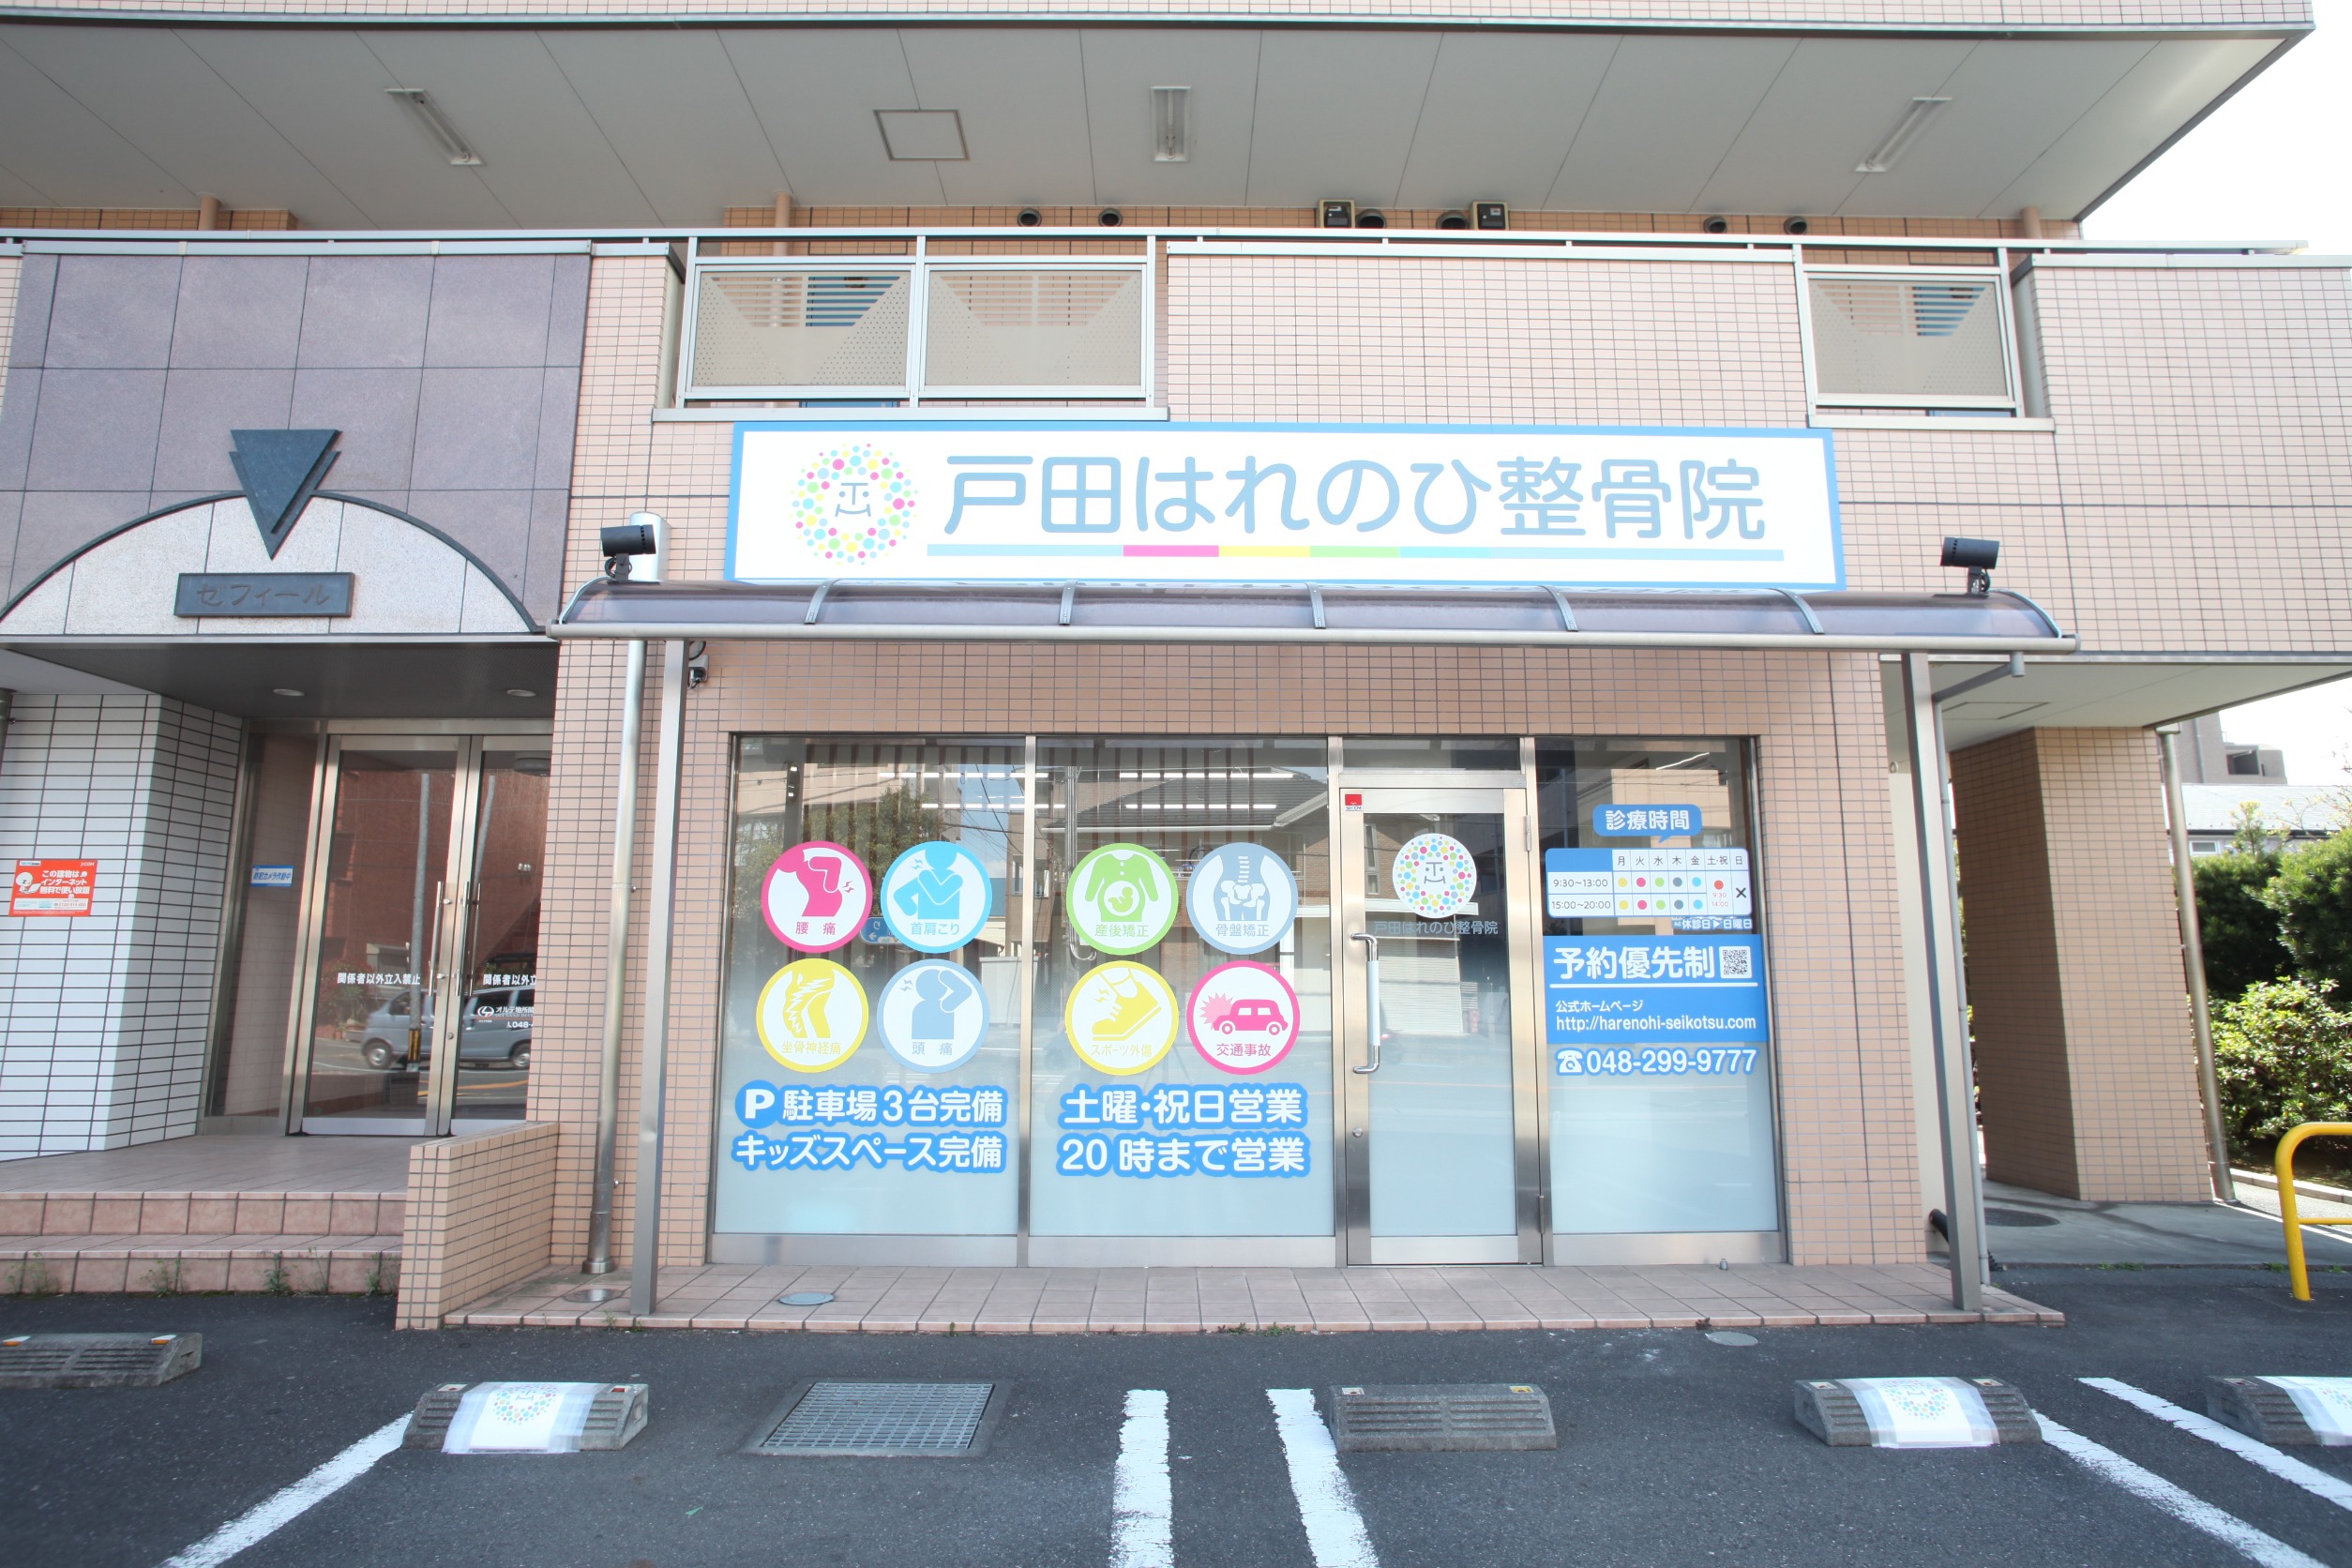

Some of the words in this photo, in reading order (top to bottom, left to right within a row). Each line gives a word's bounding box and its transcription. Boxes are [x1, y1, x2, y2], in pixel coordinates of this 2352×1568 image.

[944, 455, 1767, 541] 戸田はれのひ整骨院
[197, 583, 330, 607] ゼフィール
[1606, 809, 1690, 831] 診療時間
[1617, 855, 1626, 867] 月
[1636, 855, 1645, 866] 火
[1653, 855, 1664, 866] 水
[1671, 855, 1682, 866] 木
[1690, 854, 1700, 866] 金
[1735, 855, 1743, 865] 日
[795, 921, 837, 935] 腰痛
[911, 922, 960, 936] 首肩こり
[1095, 924, 1149, 938] 産後矯正
[1215, 924, 1270, 937] 骨盤矯正
[1374, 921, 1499, 935] 戸田はれのひ整骨院
[1682, 919, 1711, 929] 休診日
[1723, 919, 1752, 929] 日曜日
[1553, 946, 1714, 979] 予約優先制
[338, 972, 420, 985] 関係者以外立入禁止
[1555, 1000, 1643, 1013] 公式ホームページ
[1557, 1016, 1756, 1033] http://harenohi-seikotsu.com
[781, 1041, 841, 1055] 坐骨神経痛
[912, 1041, 953, 1056] 頭痛
[1091, 1044, 1153, 1058] スポーツ外傷
[1216, 1043, 1272, 1057] 交通事故
[1586, 1048, 1756, 1074] 048-299-9777
[782, 1090, 1003, 1123] 駐車場3台完備
[1064, 1089, 1302, 1123] 土曜・祝日営業
[736, 1134, 1003, 1168] キッズスペース完備
[1063, 1138, 1304, 1172] 20時まで営業
